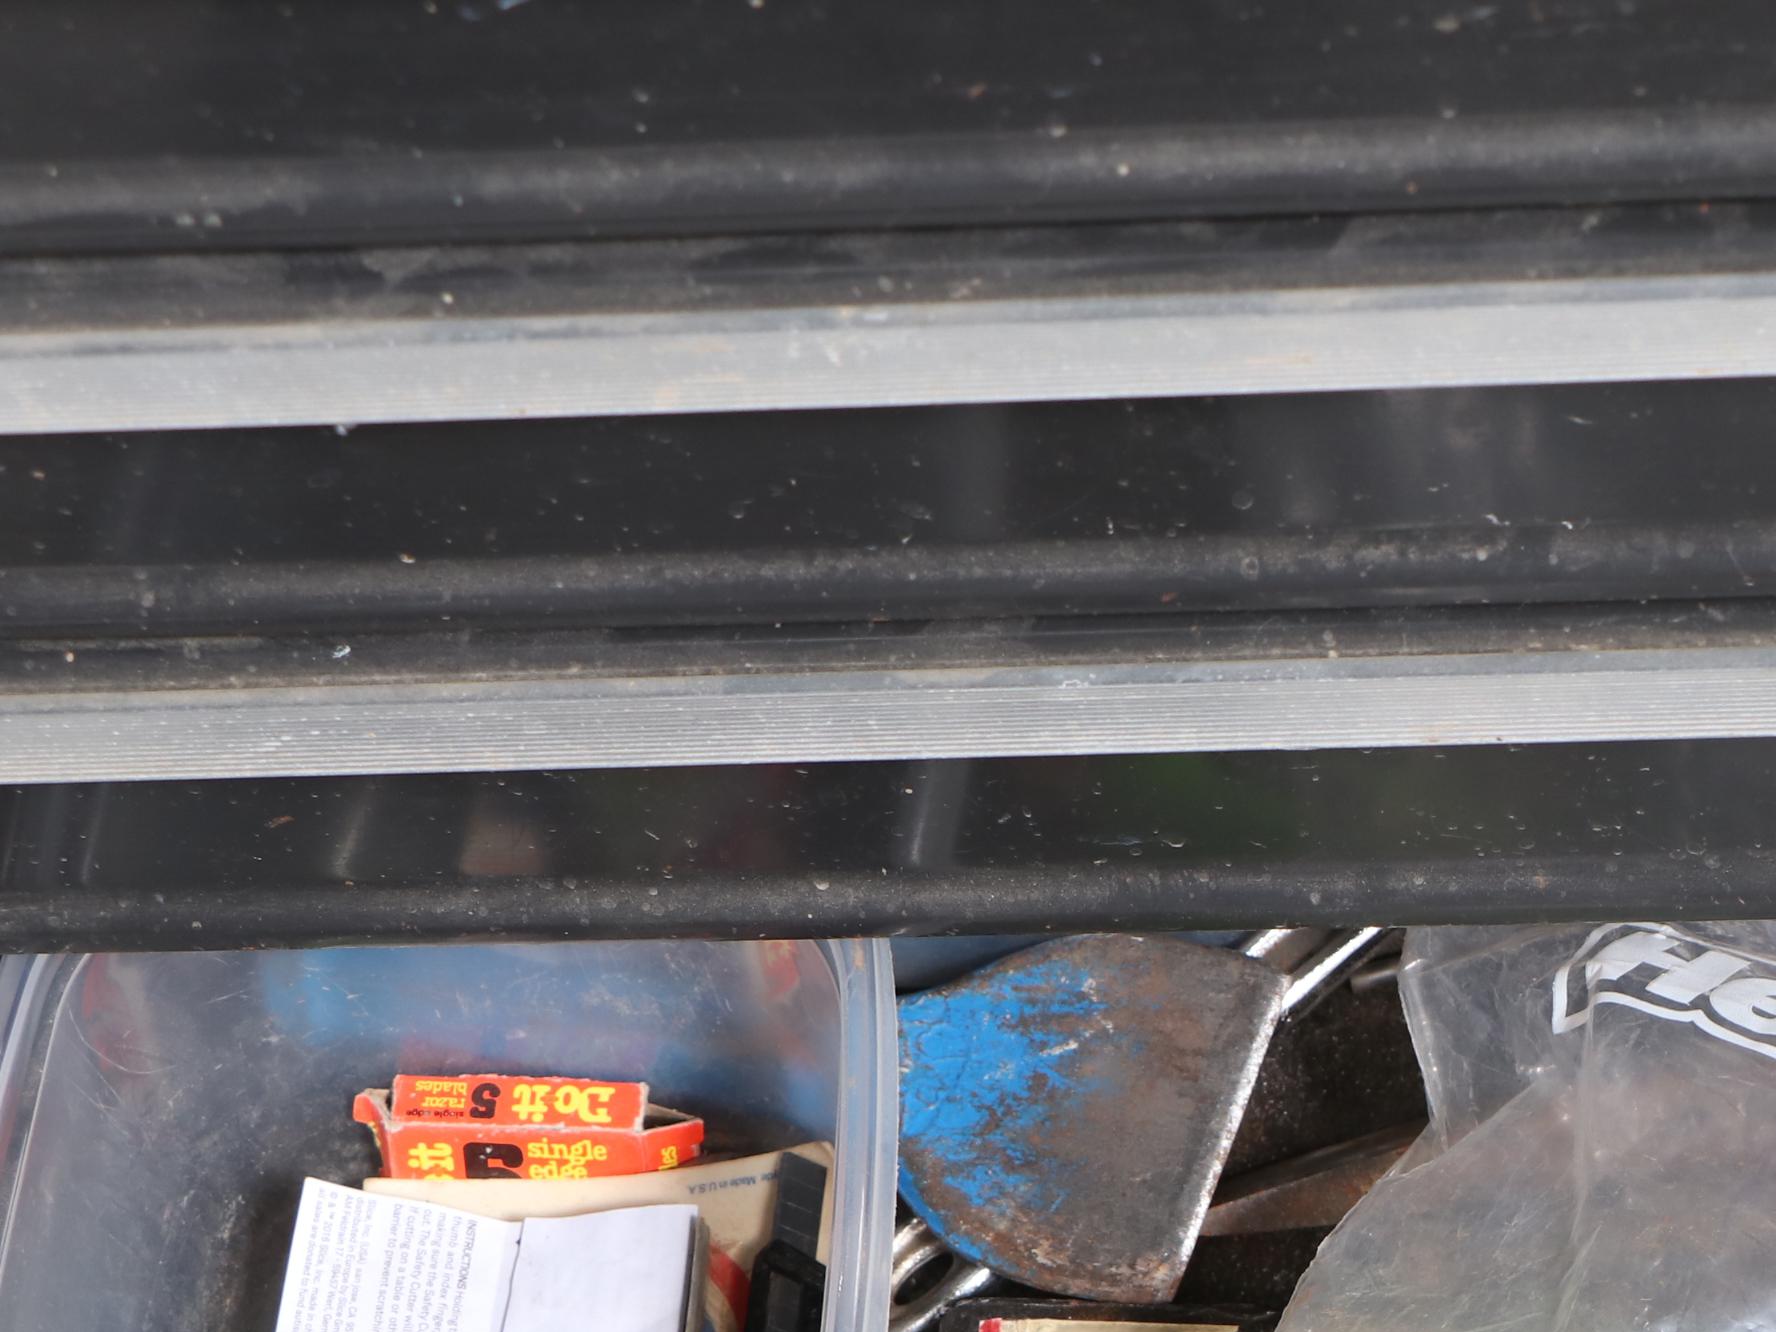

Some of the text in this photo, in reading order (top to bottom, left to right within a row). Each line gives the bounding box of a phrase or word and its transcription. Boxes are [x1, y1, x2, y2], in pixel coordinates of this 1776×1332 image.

[414, 1080, 468, 1096] blades
[470, 1082, 501, 1119] 5
[422, 1096, 466, 1109] razor
[512, 1084, 550, 1123] it
[526, 1138, 608, 1165] single
